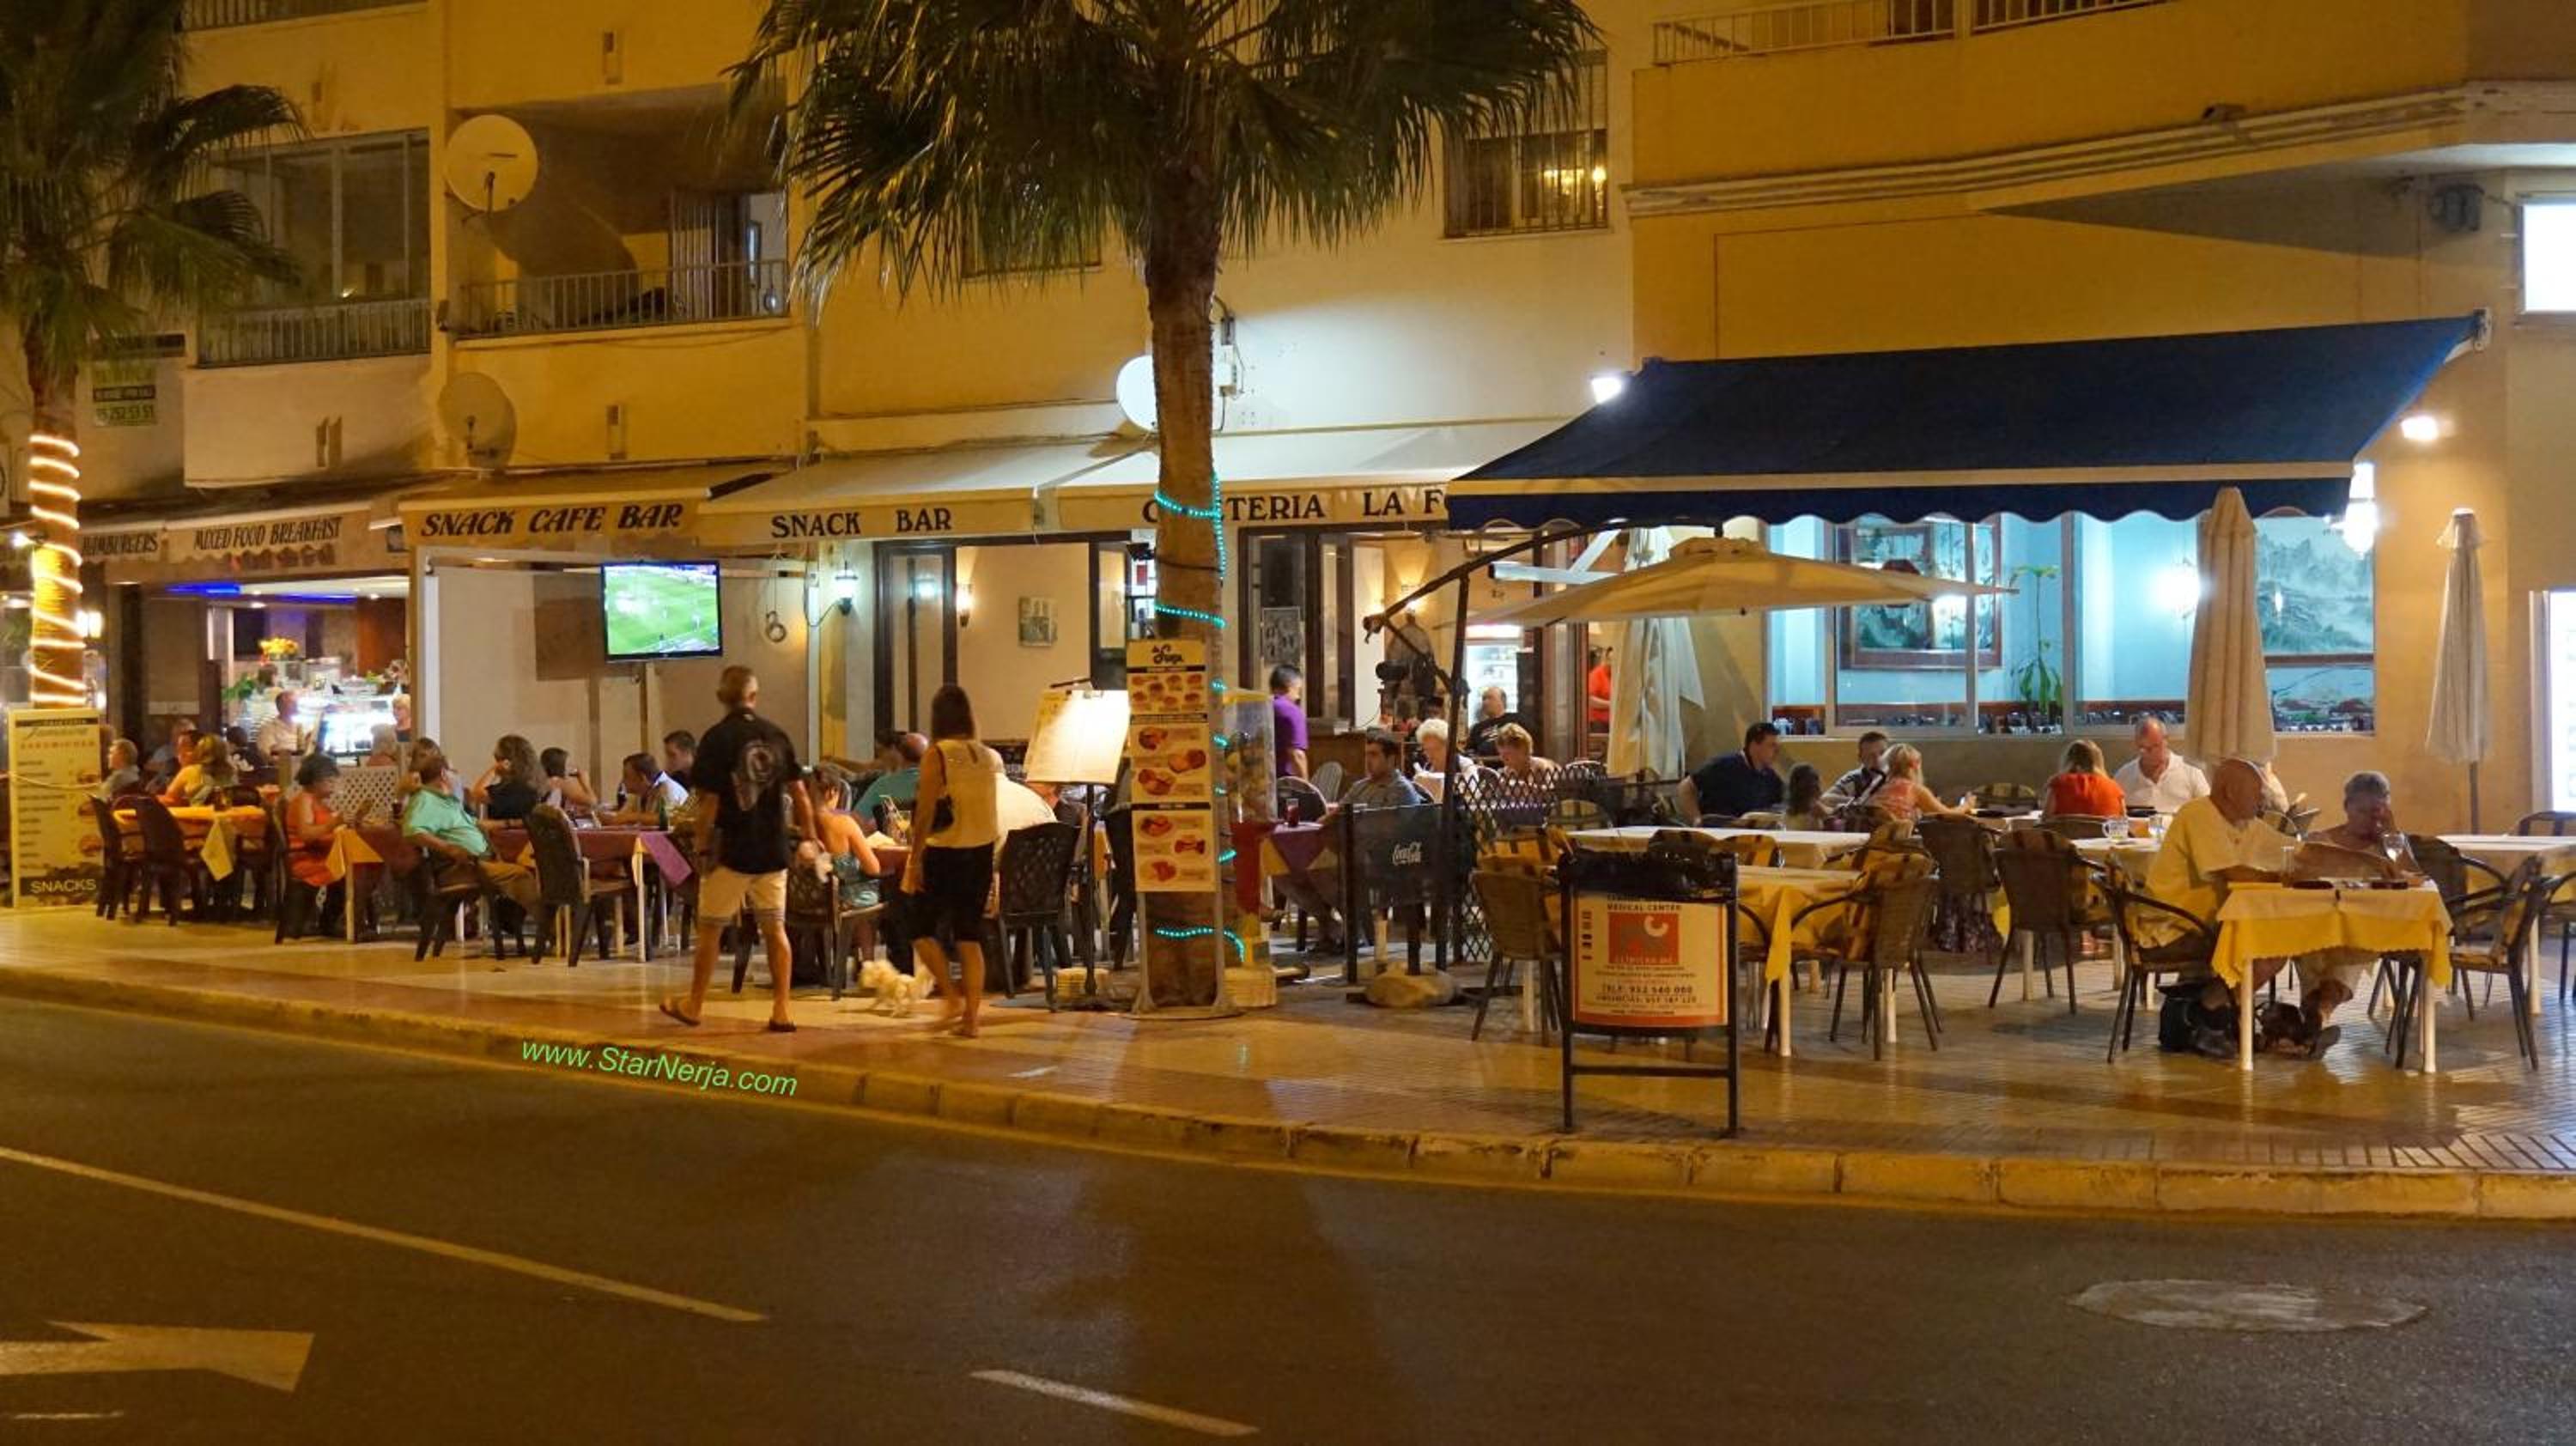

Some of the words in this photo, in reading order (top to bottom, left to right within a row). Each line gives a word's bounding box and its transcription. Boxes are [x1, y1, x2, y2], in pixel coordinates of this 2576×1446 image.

[421, 510, 514, 537] SNACK
[527, 506, 606, 532] CAFE
[617, 503, 683, 530] BAR
[771, 512, 861, 538] SNACK
[896, 507, 952, 532] BAR
[1142, 495, 1326, 522] CTERIA
[1363, 492, 1404, 517] LA
[193, 529, 232, 550] MIXED
[233, 525, 266, 548] FOOD
[269, 517, 343, 545] BREAKFAST
[30, 878, 96, 894] SNACKS
